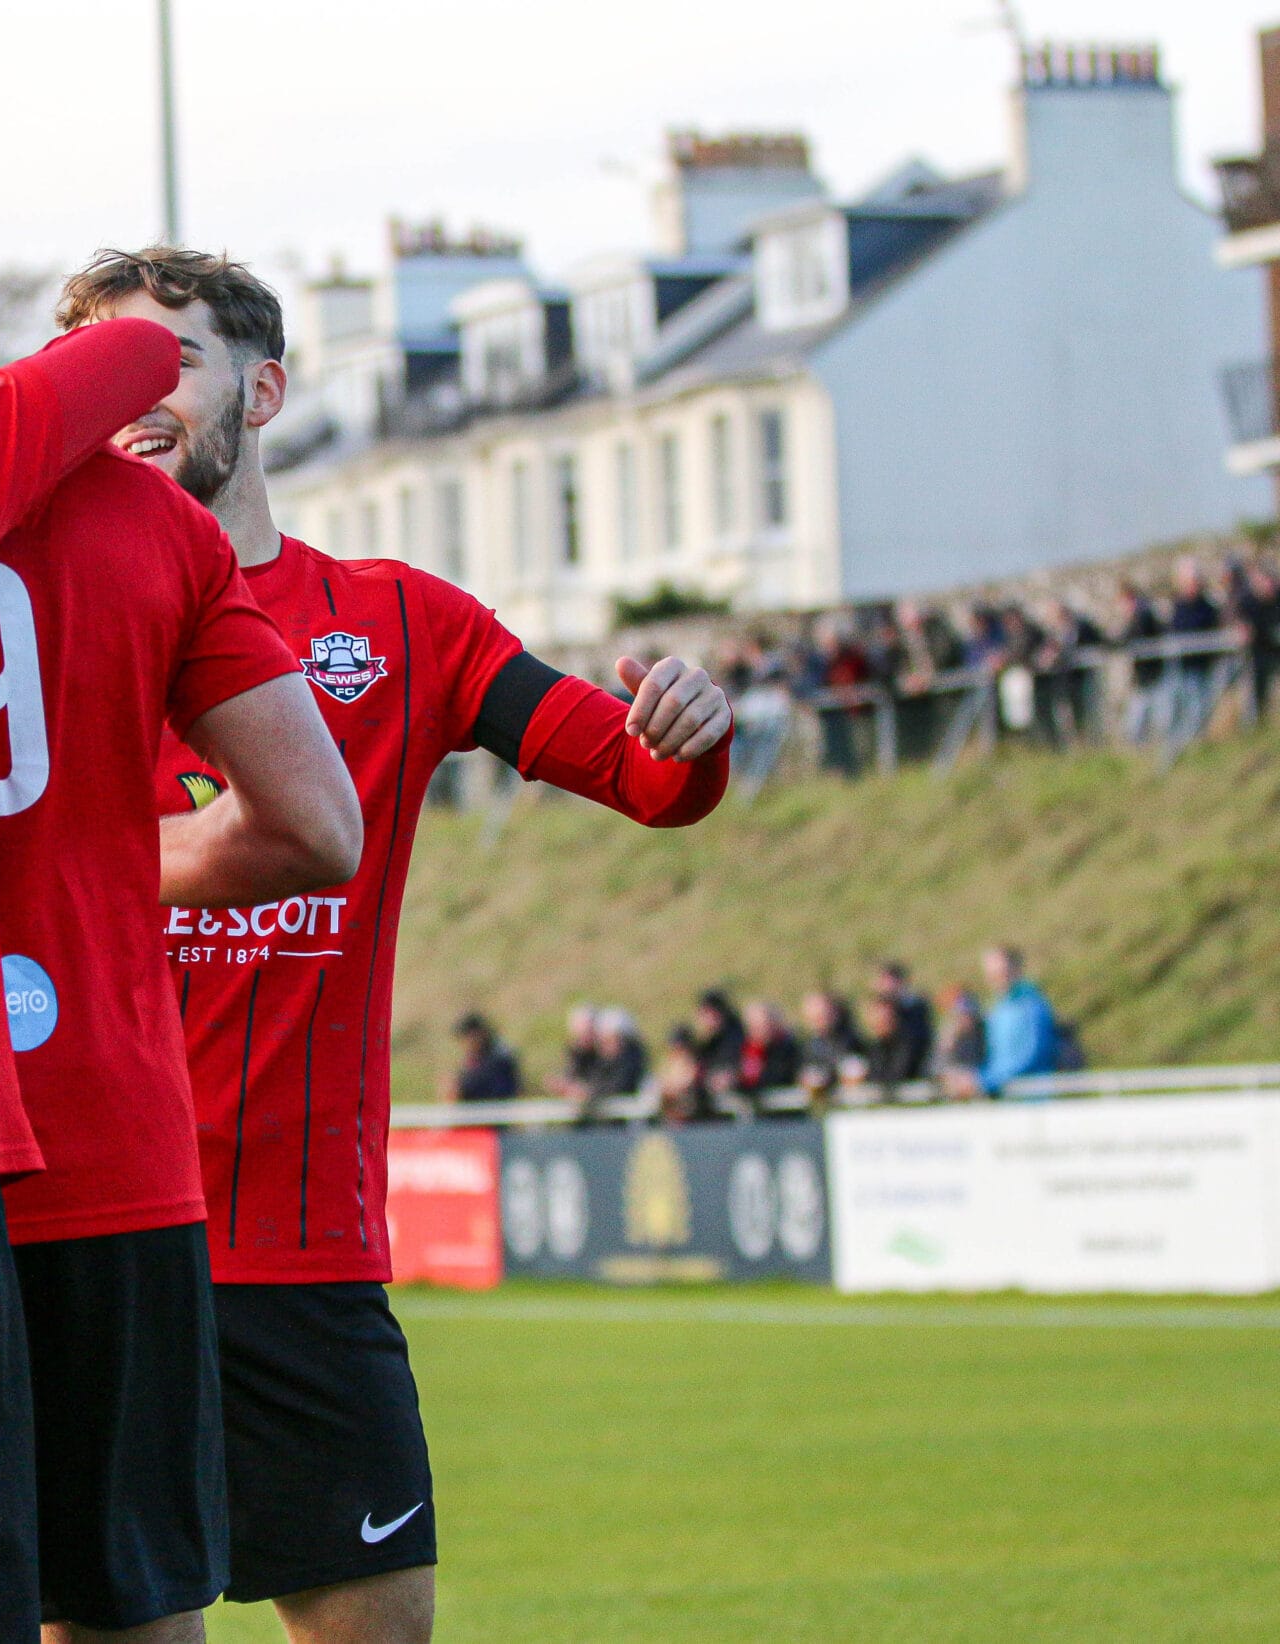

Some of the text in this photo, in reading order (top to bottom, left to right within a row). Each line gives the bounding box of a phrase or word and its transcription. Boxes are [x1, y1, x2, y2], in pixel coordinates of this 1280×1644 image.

[315, 670, 372, 684] LEWES
[335, 687, 356, 696] FC
[178, 945, 270, 964] EST 1874
